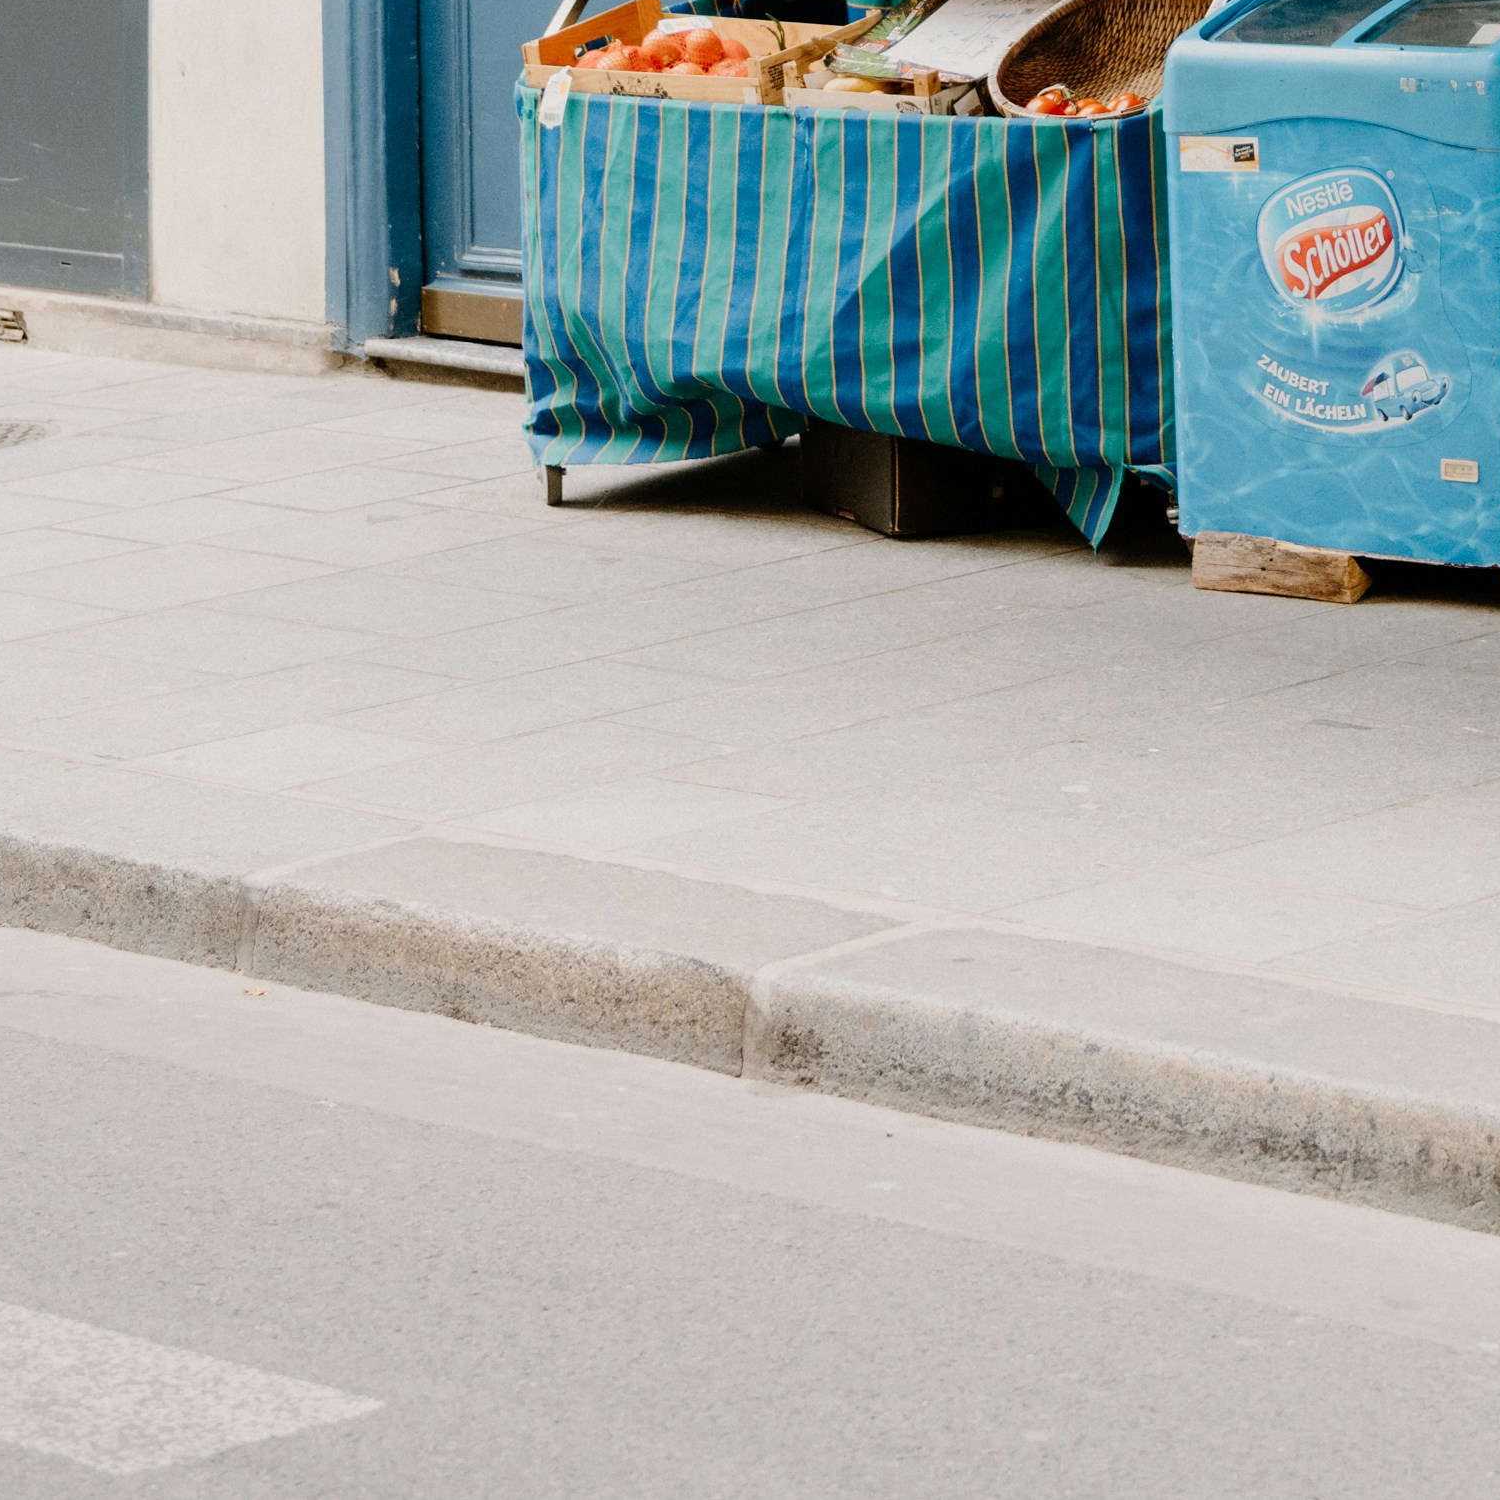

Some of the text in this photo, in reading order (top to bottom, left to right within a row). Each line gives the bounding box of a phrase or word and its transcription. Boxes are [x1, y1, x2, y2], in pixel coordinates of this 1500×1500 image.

[1285, 178, 1353, 220] Nestlé
[1283, 217, 1386, 299] Schöller
[1257, 354, 1329, 396] ZAUBERT
[1263, 383, 1367, 421] EIN LÄCHELN
